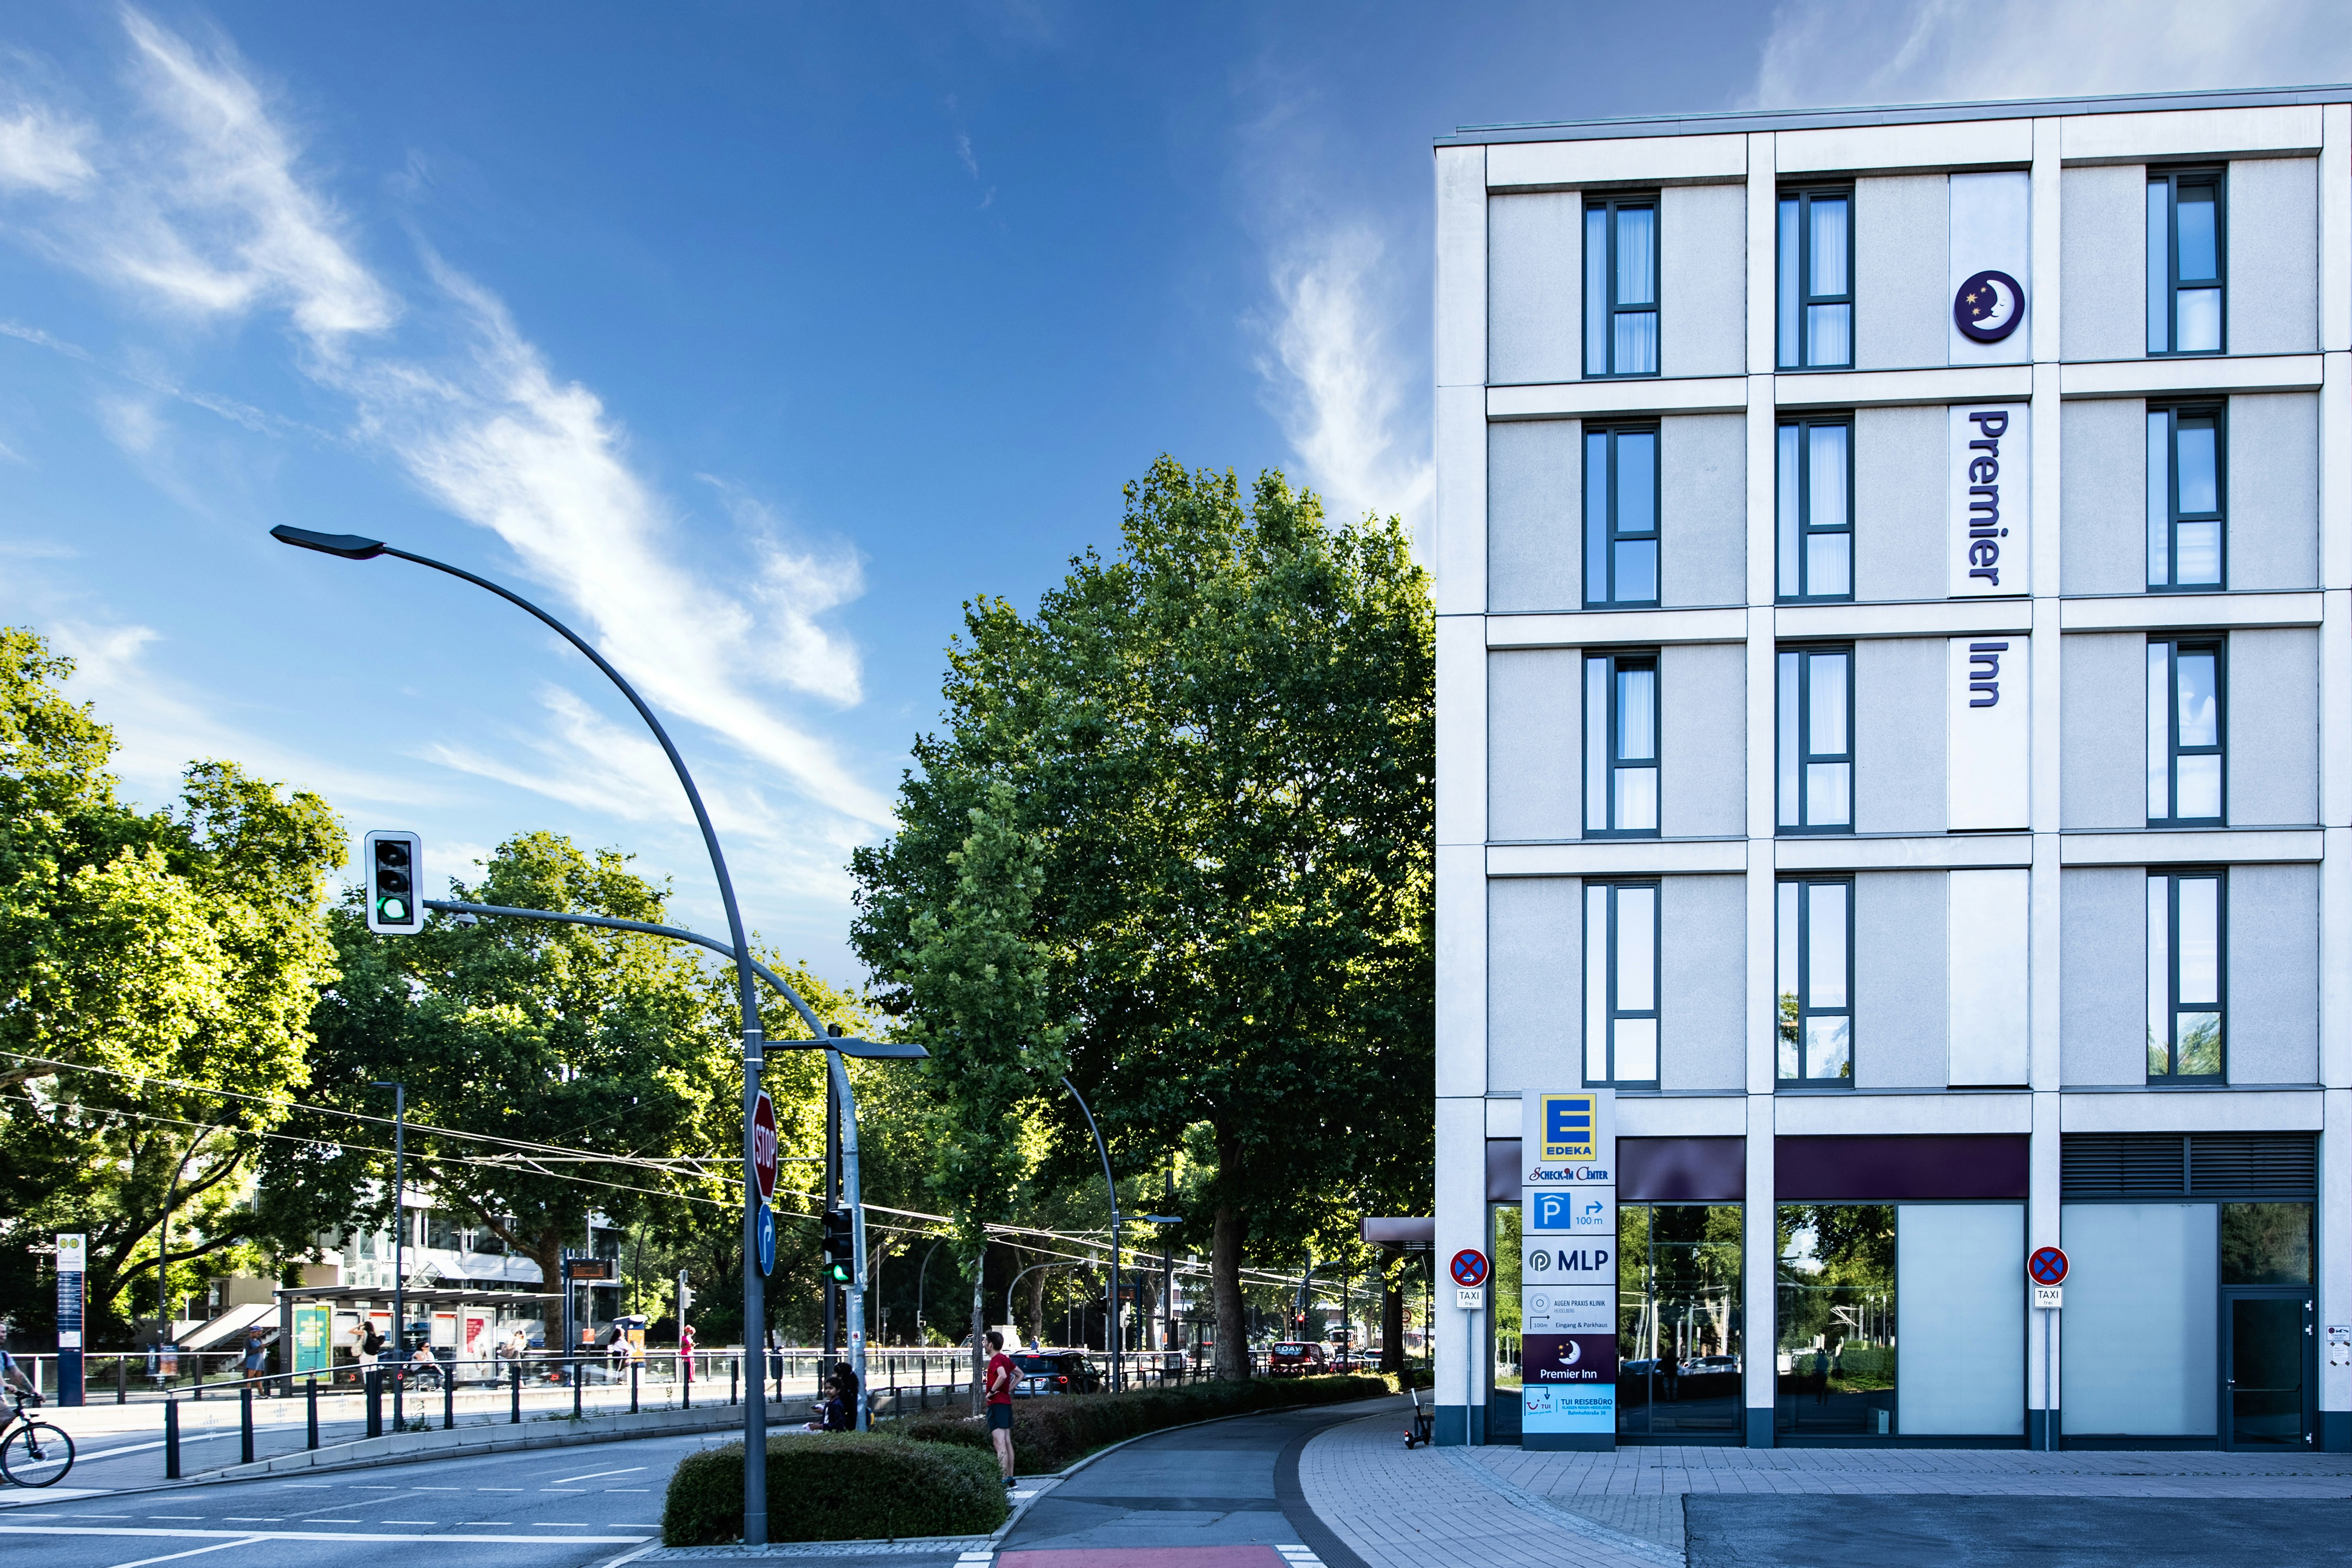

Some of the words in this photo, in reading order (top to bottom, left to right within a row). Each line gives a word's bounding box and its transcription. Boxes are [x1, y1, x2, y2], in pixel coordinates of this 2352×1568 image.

[1969, 411, 2008, 586] Premier
[1970, 642, 2008, 708] Inn
[1547, 1100, 1590, 1142] E
[755, 1123, 776, 1169] STOP
[1576, 1167, 1608, 1180] CENTER
[1544, 1201, 1560, 1224] P
[1558, 1250, 1609, 1270] MLP
[1541, 1369, 1580, 1379] Premier
[1582, 1369, 1597, 1379] Inn
